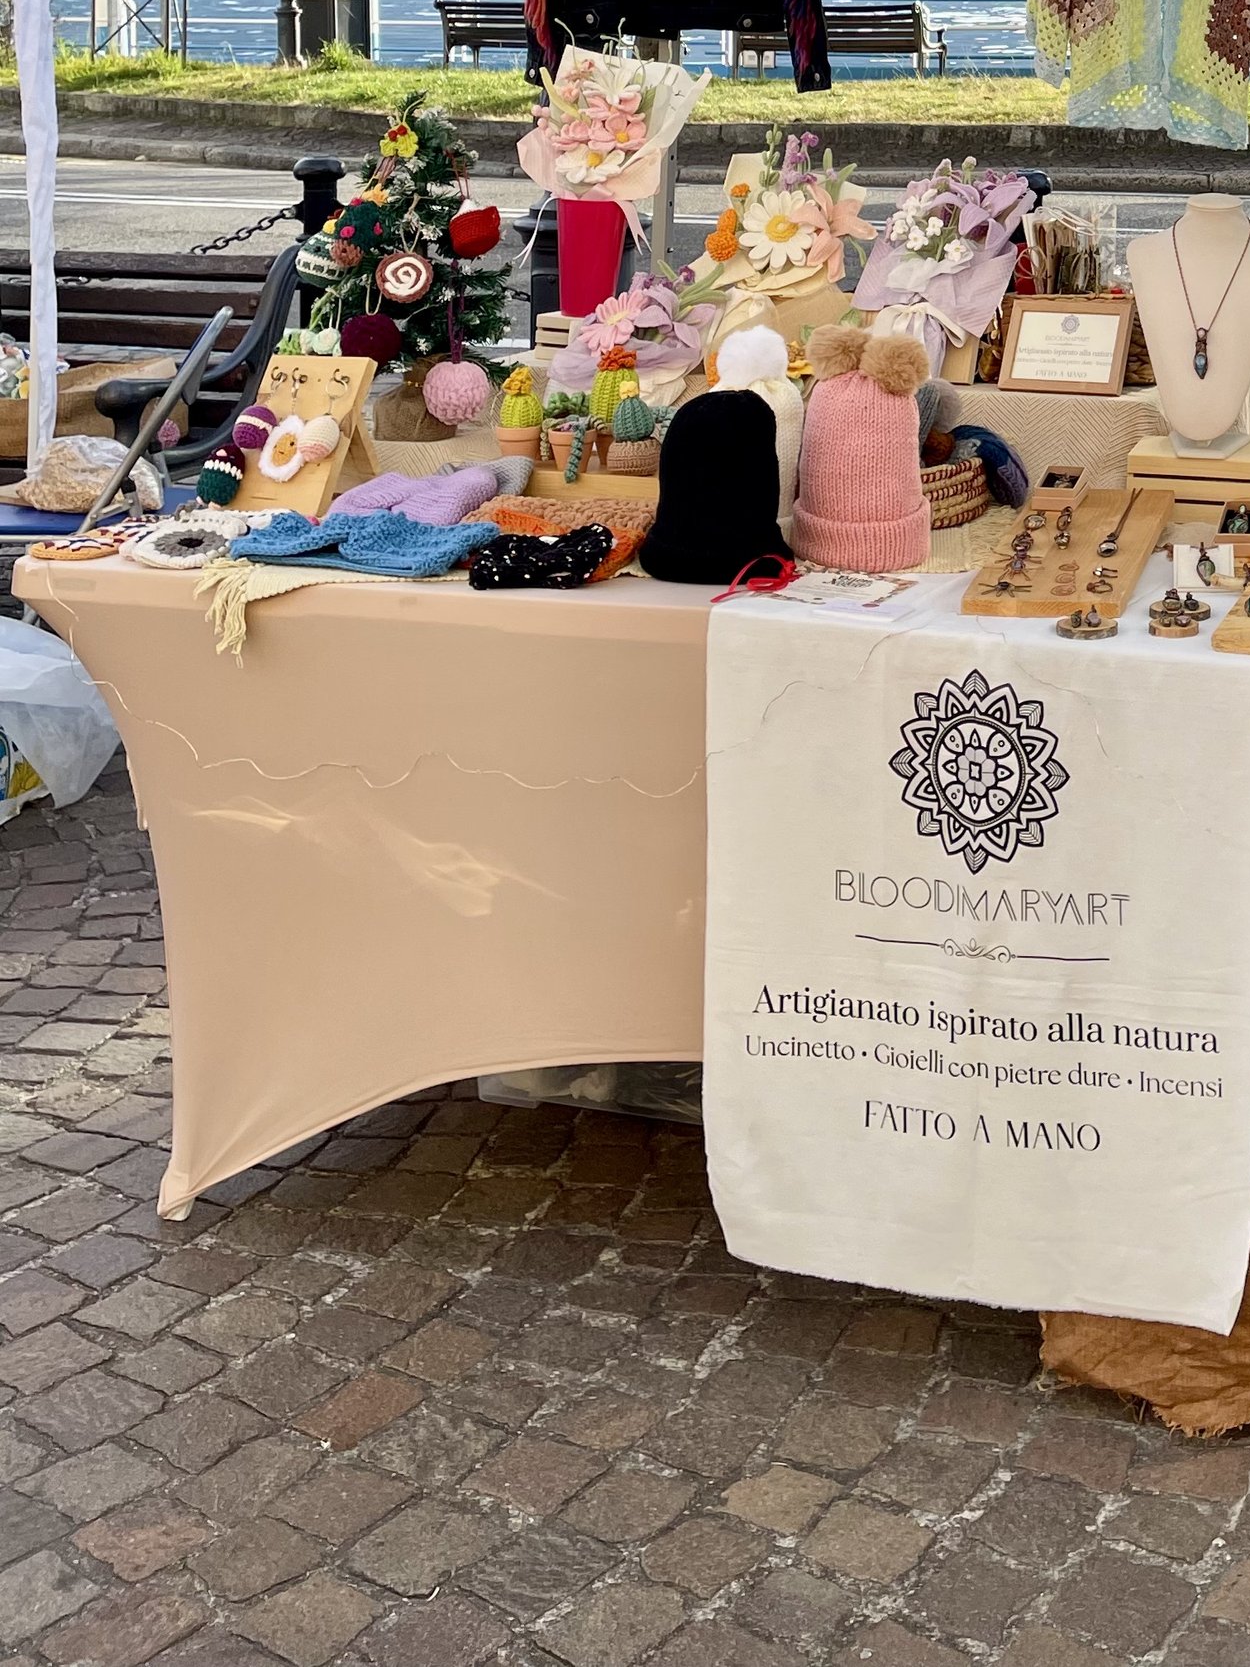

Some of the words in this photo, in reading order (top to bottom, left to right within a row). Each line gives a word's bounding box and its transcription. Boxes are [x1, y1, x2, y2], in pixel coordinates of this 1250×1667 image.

[752, 984, 920, 1026] Artigianato
[928, 1000, 1038, 1044] ispirato
[1047, 1012, 1105, 1044] alla
[1113, 1023, 1220, 1054] natura
[746, 1034, 855, 1061] Uncinetto
[874, 1042, 944, 1075] Gioielli
[948, 1062, 989, 1079] con
[995, 1063, 1062, 1088] pietre
[1067, 1062, 1121, 1089] dure
[1139, 1070, 1223, 1098] Incensi
[864, 1100, 956, 1141] FATTO
[973, 1114, 991, 1143] A
[1006, 1120, 1101, 1152] MANO
